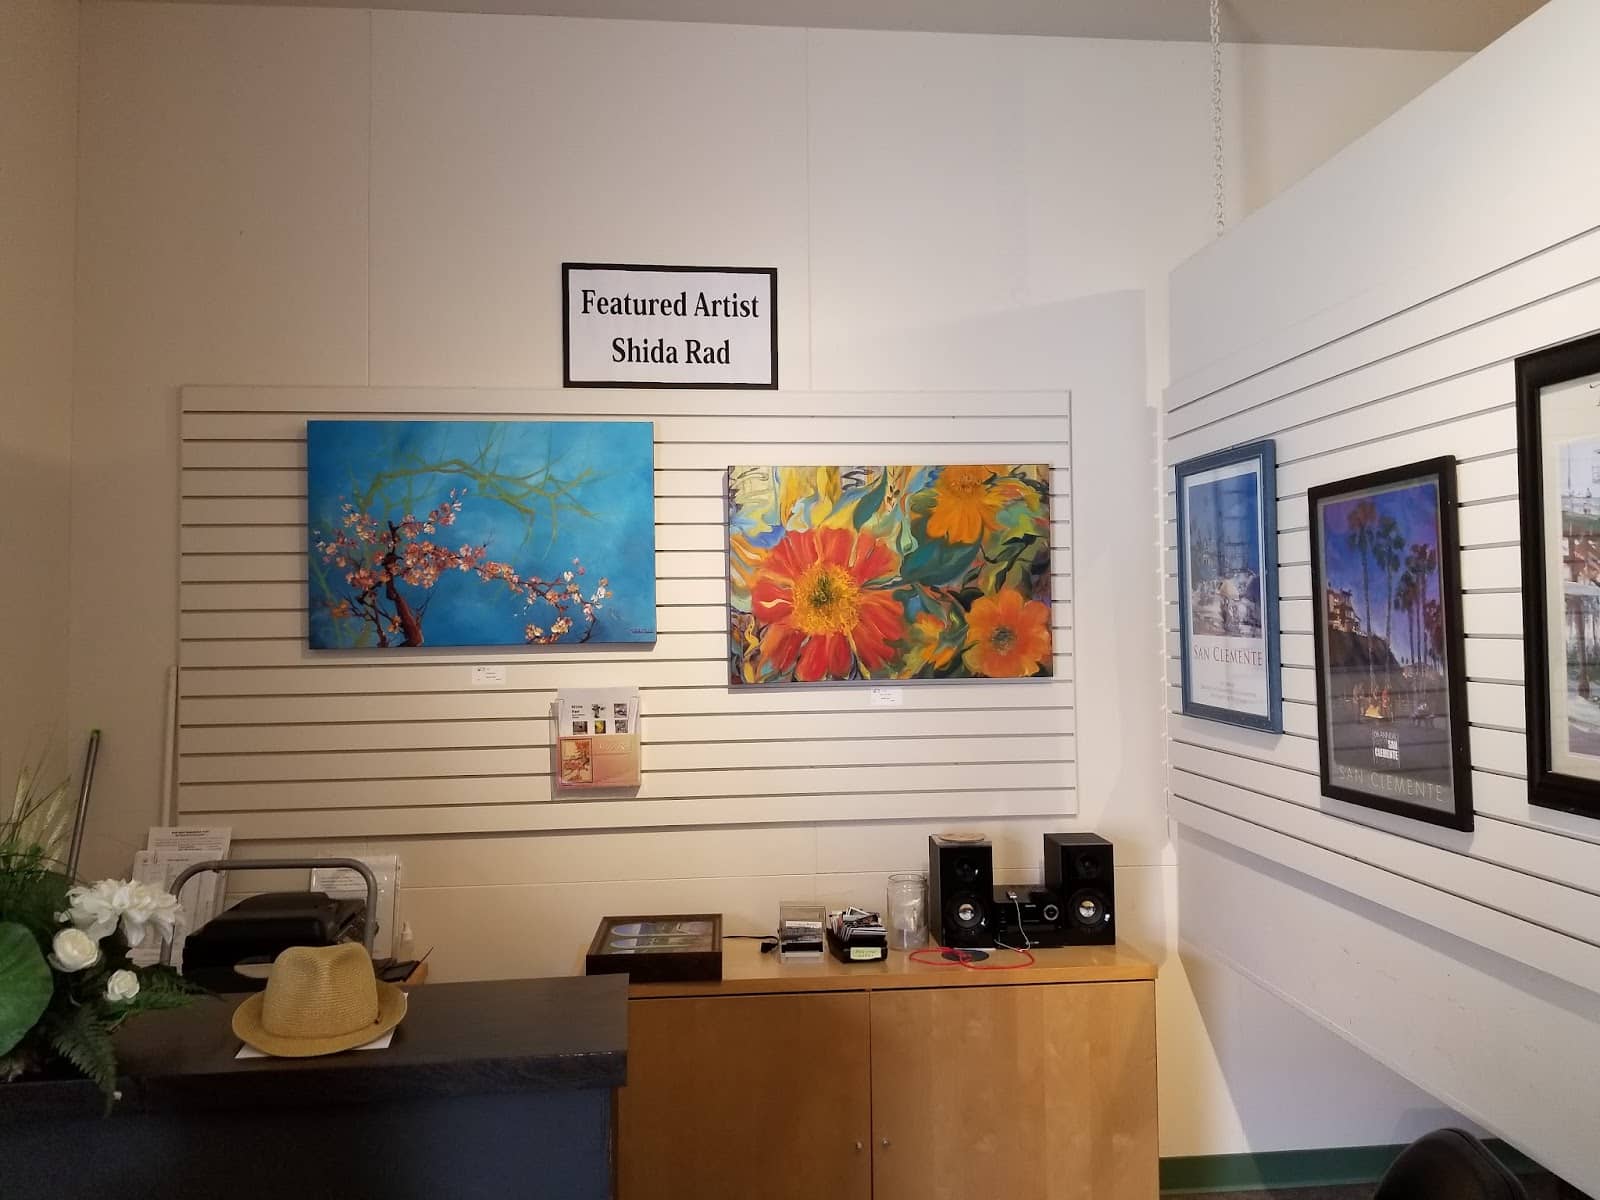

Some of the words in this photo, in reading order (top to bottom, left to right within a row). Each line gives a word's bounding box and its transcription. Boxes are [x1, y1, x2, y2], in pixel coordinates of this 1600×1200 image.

[581, 289, 687, 316] Featured
[694, 291, 759, 318] Artist
[612, 337, 679, 363] Shida
[685, 338, 730, 364] Rad
[1193, 646, 1210, 660] SAN
[1213, 646, 1263, 666] CLEMENTE
[1338, 765, 1364, 784] SAN
[1369, 771, 1443, 802] CLEMENTE
